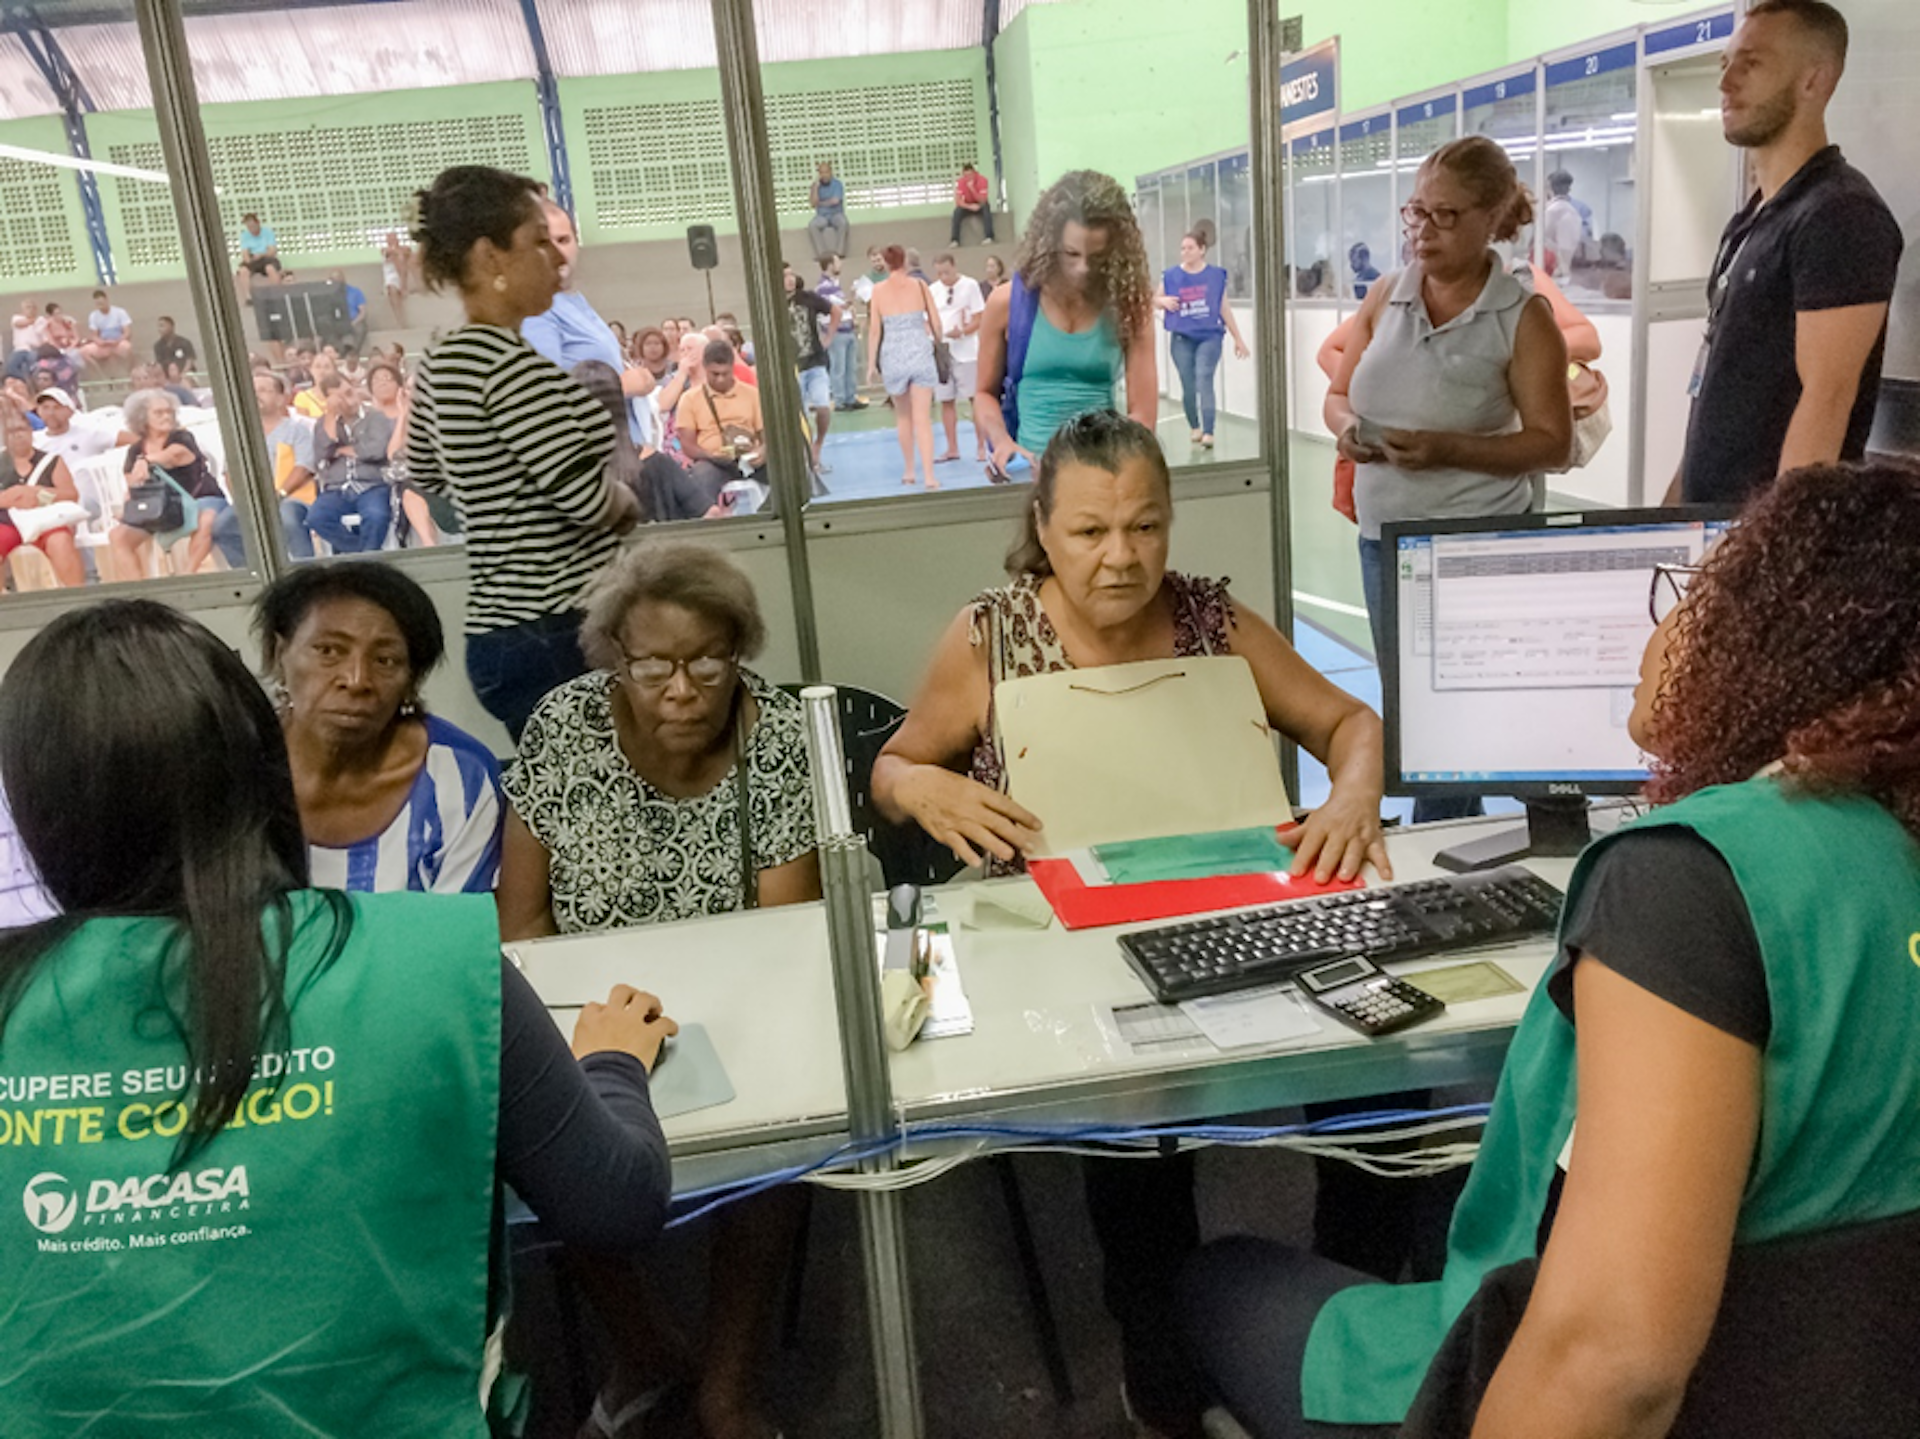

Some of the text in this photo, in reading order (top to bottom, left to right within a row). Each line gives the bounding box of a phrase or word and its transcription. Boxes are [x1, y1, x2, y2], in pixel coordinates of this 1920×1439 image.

[1696, 21, 1712, 43] 21
[1585, 55, 1599, 75] 20
[1549, 783, 1582, 795] DELL
[121, 1065, 187, 1096] SEU
[118, 1080, 334, 1141] COIGO!
[85, 1164, 250, 1213] DACASA
[82, 1199, 250, 1226] FINANCEIRA
[37, 1223, 252, 1252] Mais crédito. Mais confiança.
